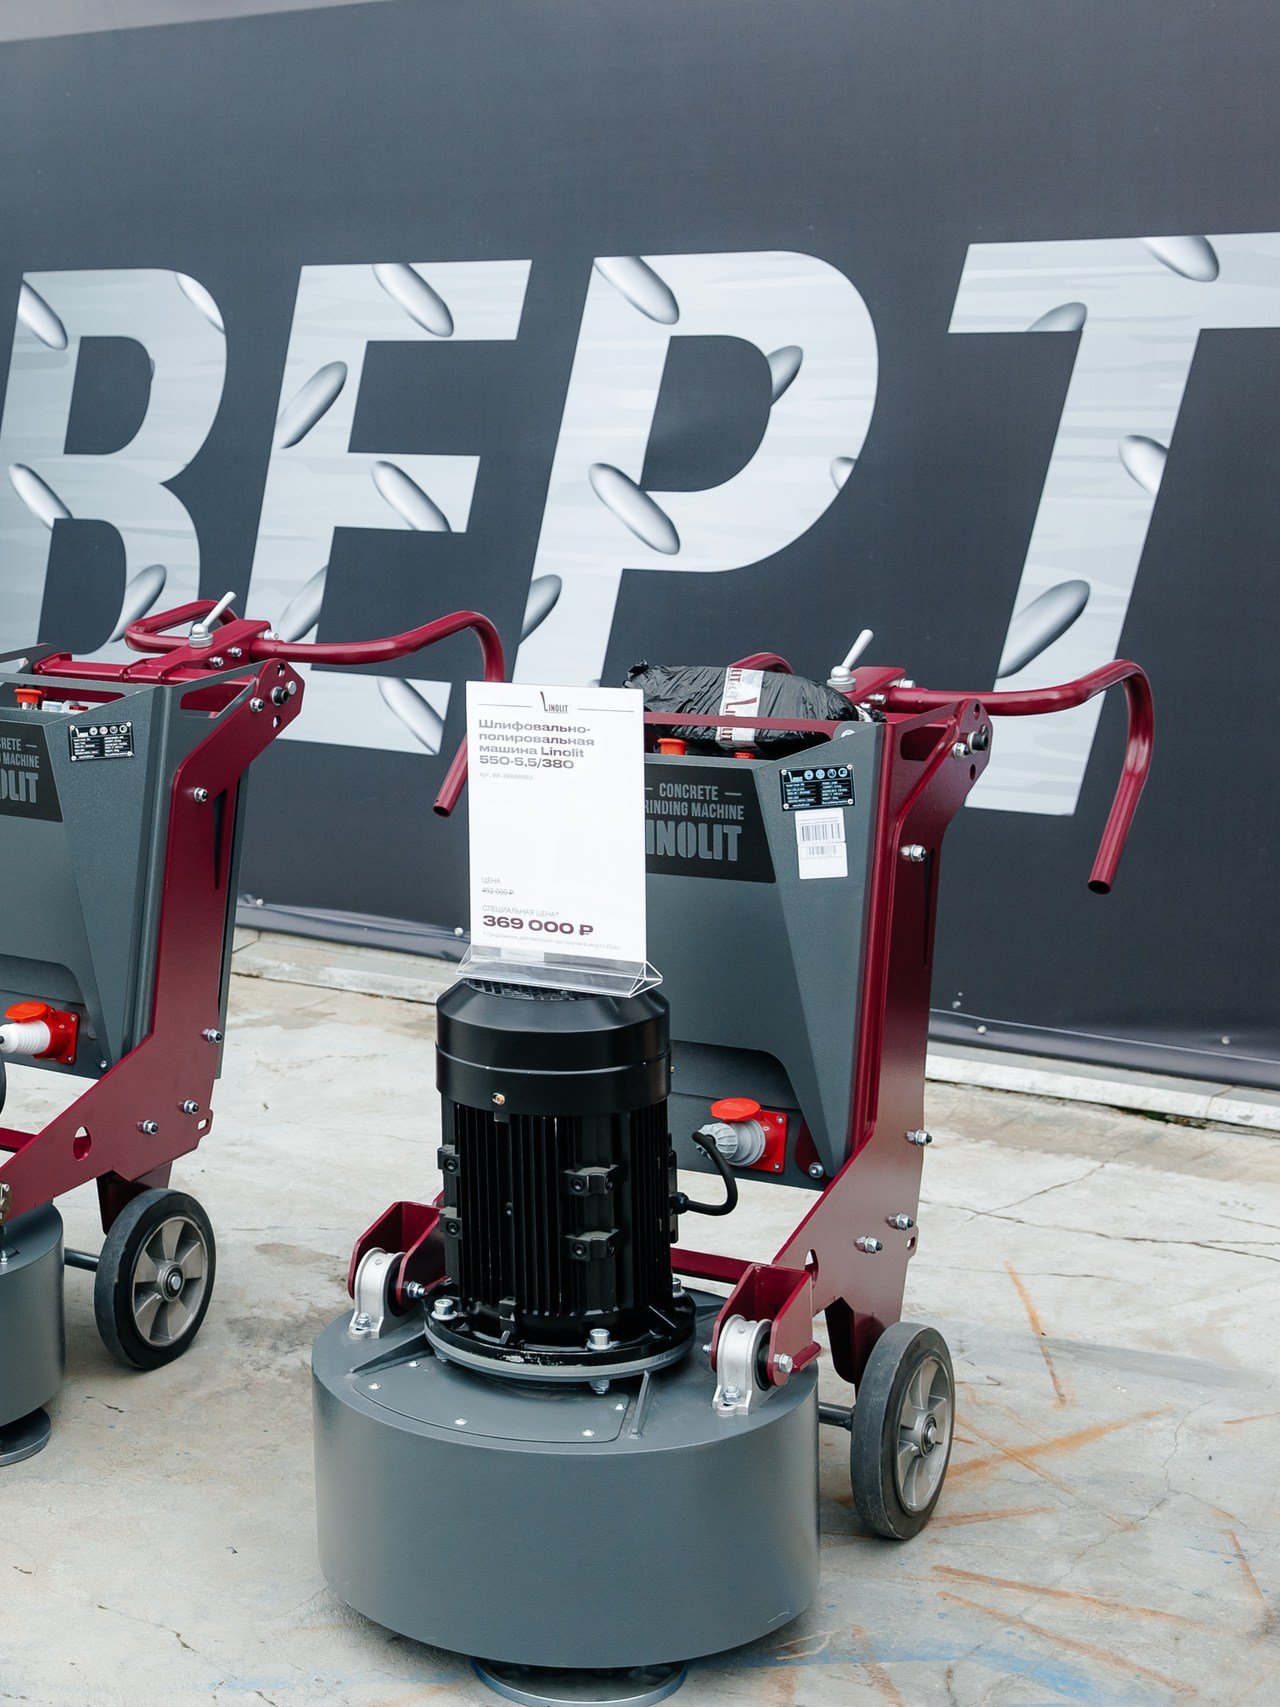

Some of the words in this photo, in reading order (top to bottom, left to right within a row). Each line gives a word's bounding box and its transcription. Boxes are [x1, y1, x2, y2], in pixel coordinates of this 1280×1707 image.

[540, 691, 569, 713] LINOLIT
[478, 719, 591, 734] Шлифовально-
[479, 732, 595, 747] полировальная
[479, 745, 538, 756] машина
[540, 746, 585, 758] Linolit
[2, 752, 40, 768] MACHINE
[479, 755, 575, 770] 550-5,5/380
[659, 782, 718, 800] CONCRETE
[645, 799, 689, 816] RINDING
[691, 802, 744, 820] MACHINE
[645, 819, 742, 861] INOLIT
[481, 876, 501, 884] ЦЕНА
[482, 904, 535, 916] СПЕЦИАЛЬНАЯ
[483, 915, 524, 930] 369
[528, 919, 575, 935] 000
